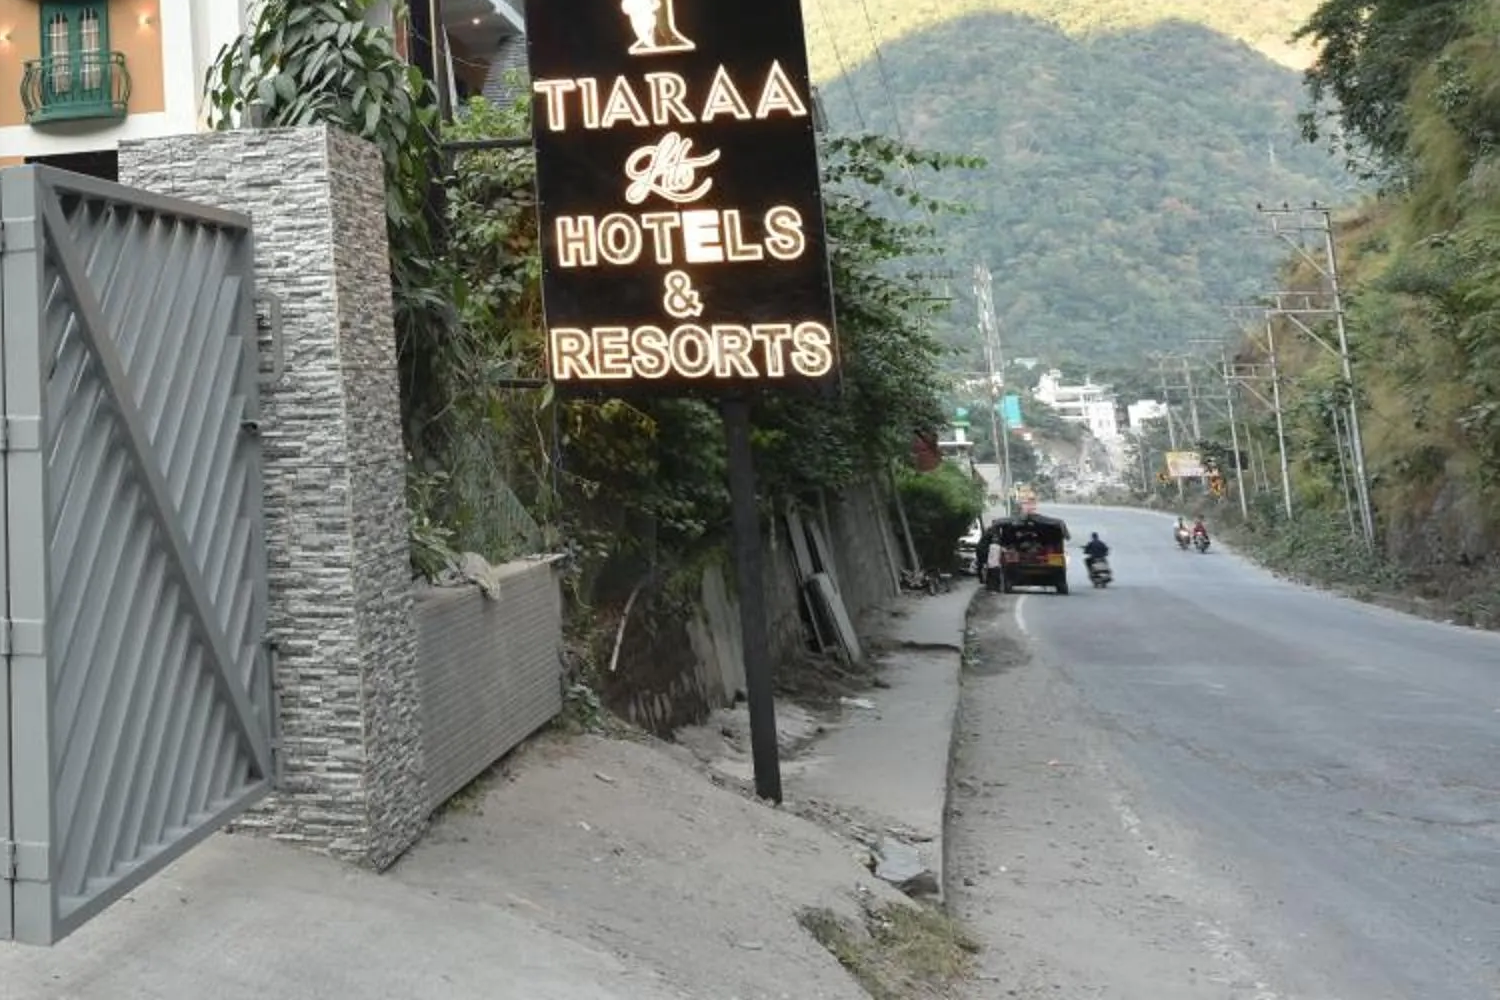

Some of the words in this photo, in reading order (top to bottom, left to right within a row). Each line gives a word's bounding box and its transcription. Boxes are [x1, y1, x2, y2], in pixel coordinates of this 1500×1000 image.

[534, 60, 807, 131] TIARAA
[555, 206, 805, 267] HOTELS
[664, 271, 703, 318] &
[549, 322, 833, 380] RESORTS
